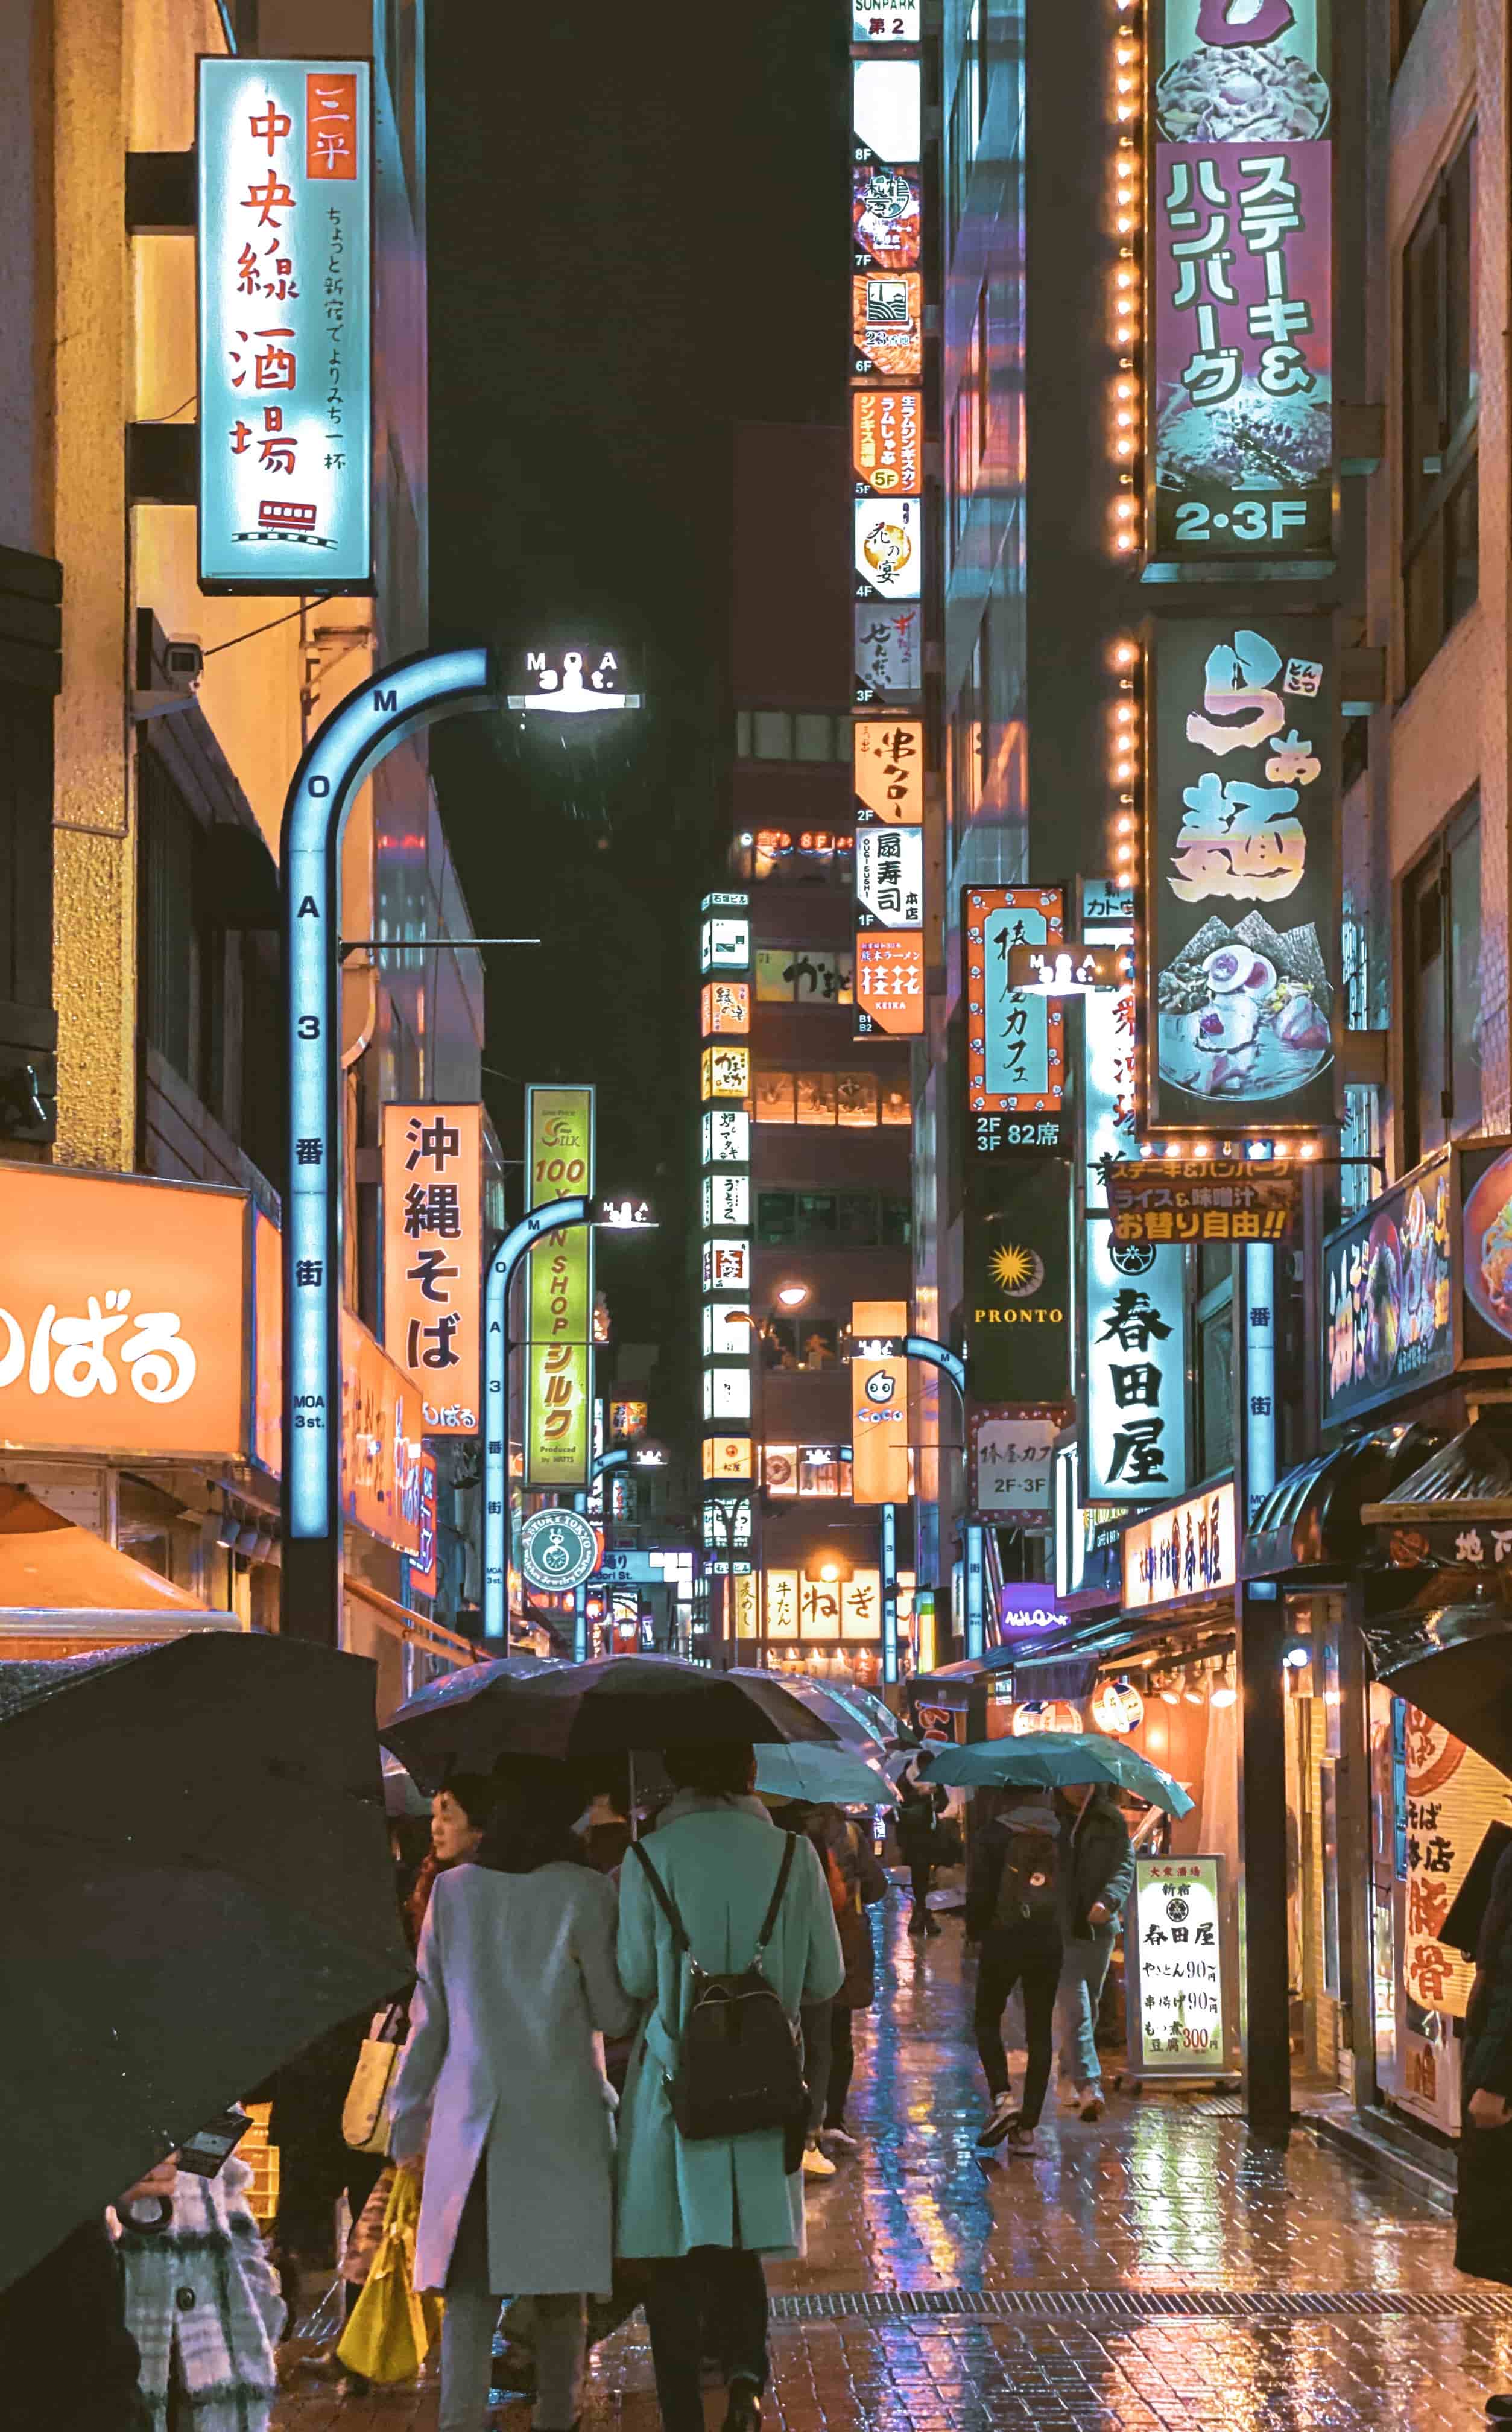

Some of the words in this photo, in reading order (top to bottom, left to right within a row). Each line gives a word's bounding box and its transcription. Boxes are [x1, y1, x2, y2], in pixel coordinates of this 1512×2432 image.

[313, 87, 350, 170] 三平
[855, 149, 872, 160] 8F
[855, 255, 871, 266] 7F
[228, 100, 300, 475] 中央線酒場
[1166, 160, 1238, 401] ハンバーグ
[324, 207, 347, 469] ちょっと新宿でよりみち一杯
[856, 361, 872, 372] 6F
[880, 397, 896, 465] ラムしゃぶ
[855, 483, 871, 494] 5F
[875, 472, 895, 486] 5F
[867, 522, 900, 584] 花の宴
[856, 586, 873, 597] 4F
[856, 691, 873, 701] 3F
[858, 810, 874, 821] 2F
[878, 832, 902, 912] 扇寿司
[906, 892, 919, 920] 本店
[859, 916, 874, 926] 1F
[861, 951, 921, 962] 熊本ラーメン
[977, 1118, 1002, 1133] 2F
[1008, 1123, 1059, 1146] 82席
[977, 1137, 1002, 1151] 3F
[535, 1158, 585, 1183] 100
[403, 1116, 463, 1369] 沖縄そば
[975, 1309, 1064, 1323] PRONTO
[544, 1344, 572, 1441] シルク
[1094, 1288, 1174, 1485] 春田屋
[294, 1395, 325, 1408] MOA
[740, 1580, 756, 1626] 麦めし
[775, 1581, 792, 1626] 牛たん
[1162, 1882, 1191, 1897] 新宿
[1143, 1921, 1216, 1946] 春田屋
